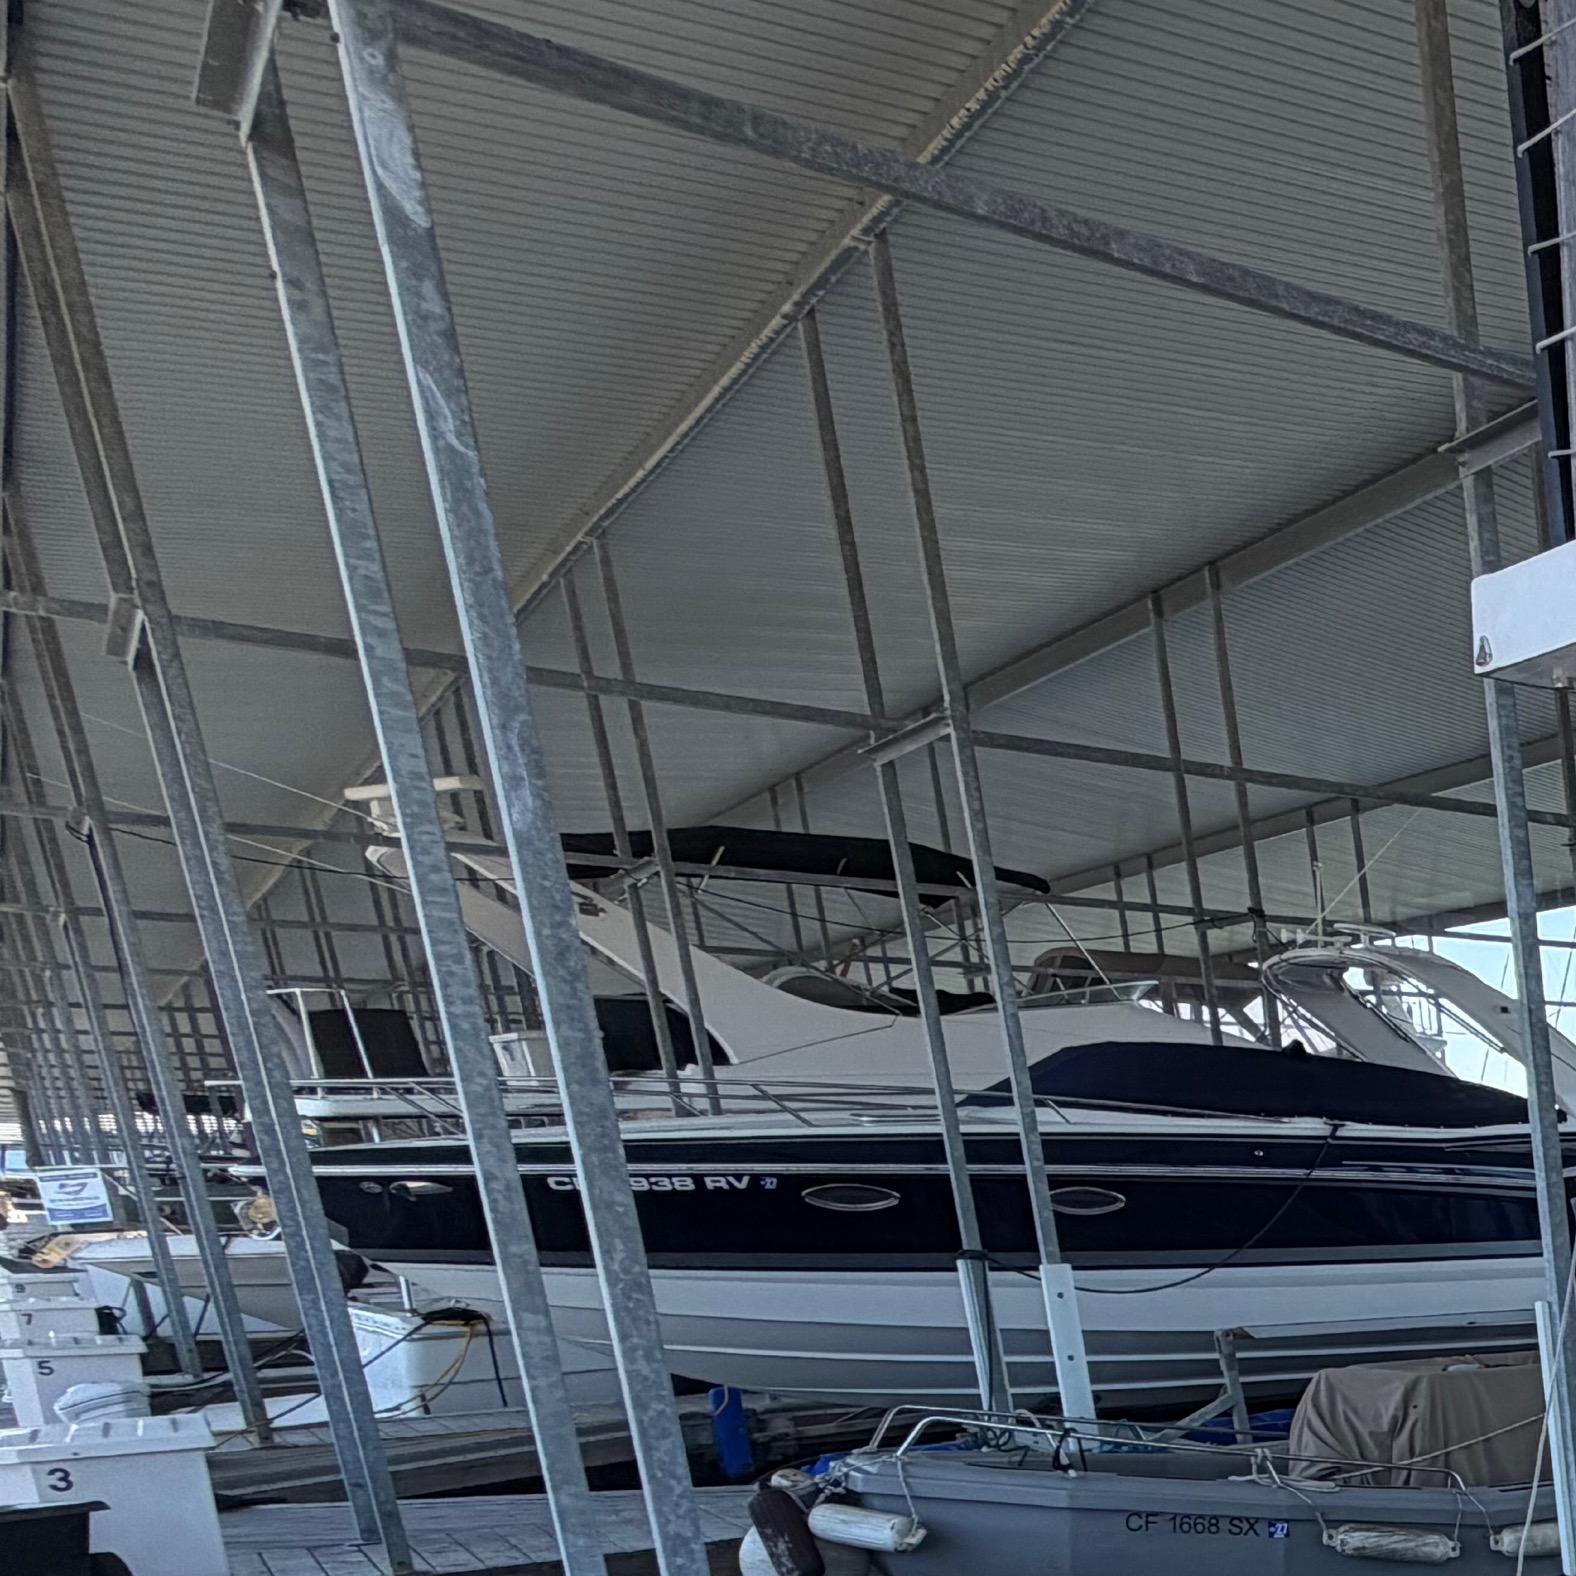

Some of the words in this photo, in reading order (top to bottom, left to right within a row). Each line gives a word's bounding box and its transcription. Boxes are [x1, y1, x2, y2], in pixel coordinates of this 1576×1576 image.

[629, 1176, 696, 1191] 938
[704, 1175, 750, 1190] RV
[21, 1313, 33, 1326] 7
[37, 1359, 55, 1377] 5
[46, 1467, 74, 1493] 3
[1125, 1512, 1160, 1532] CF
[1168, 1514, 1220, 1535] 1668
[1228, 1516, 1260, 1537] SX
